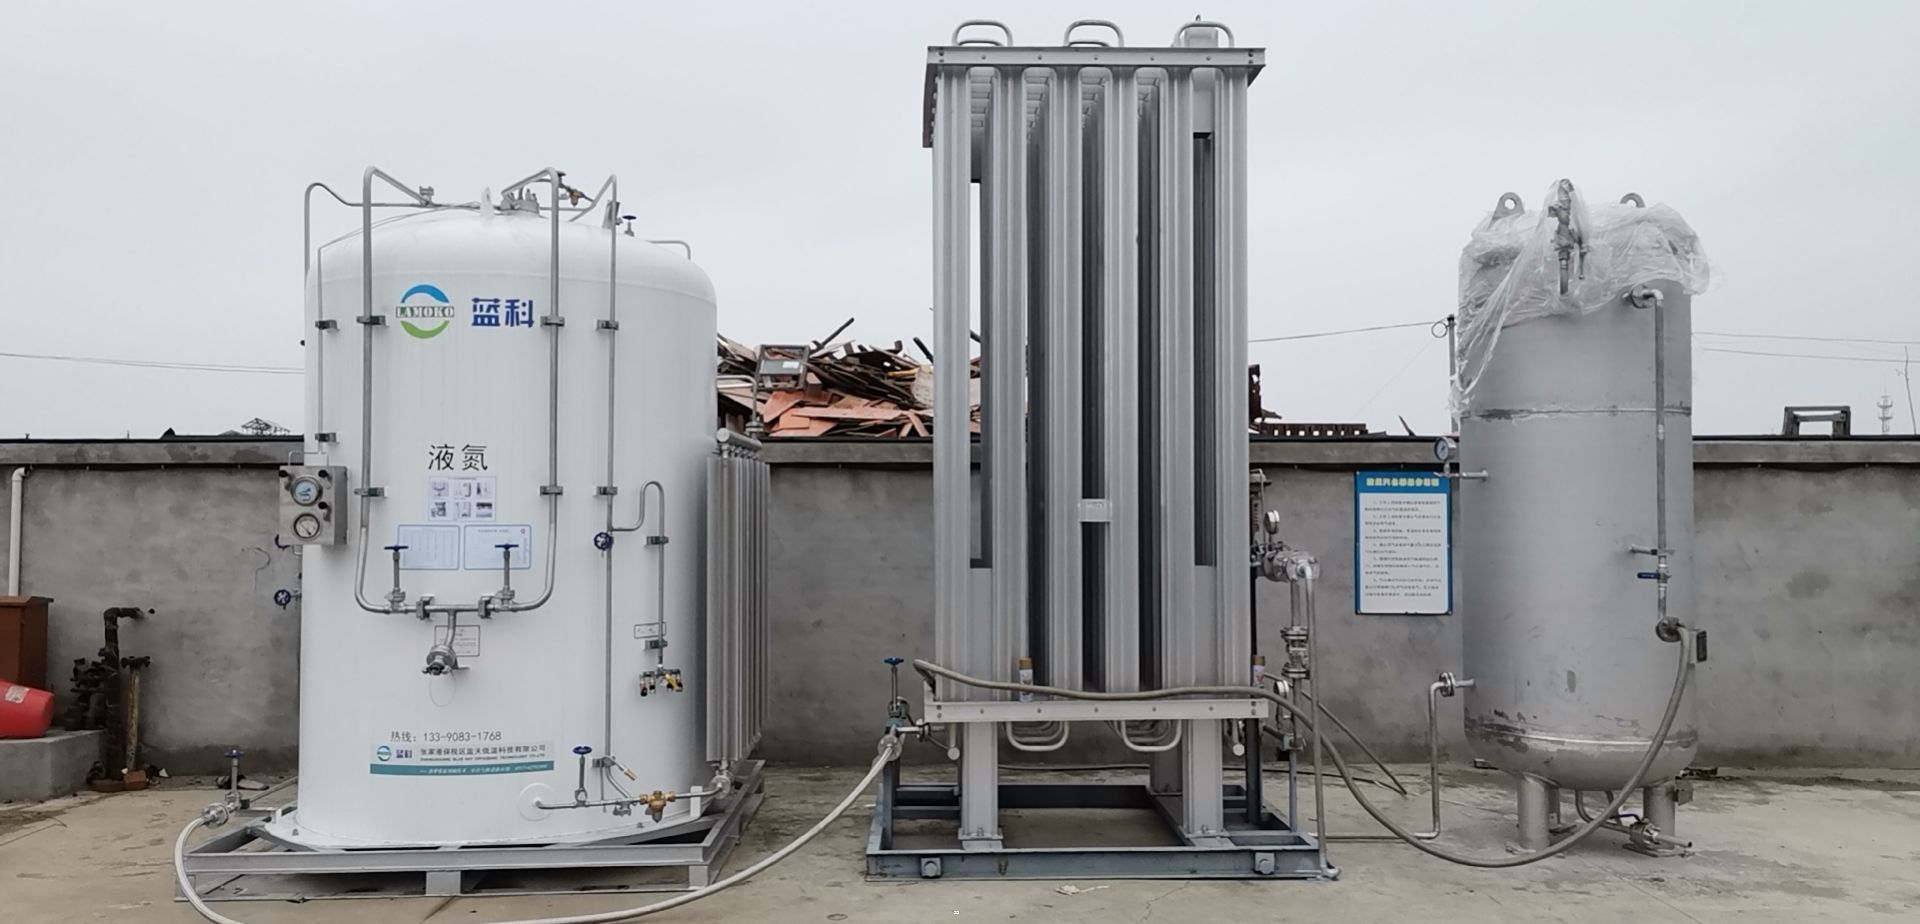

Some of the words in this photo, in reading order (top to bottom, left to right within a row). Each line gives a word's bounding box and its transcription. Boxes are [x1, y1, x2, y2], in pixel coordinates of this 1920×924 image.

[396, 306, 454, 318] LAMOKO
[471, 297, 535, 328] 蓝科
[428, 444, 488, 471] 液氮
